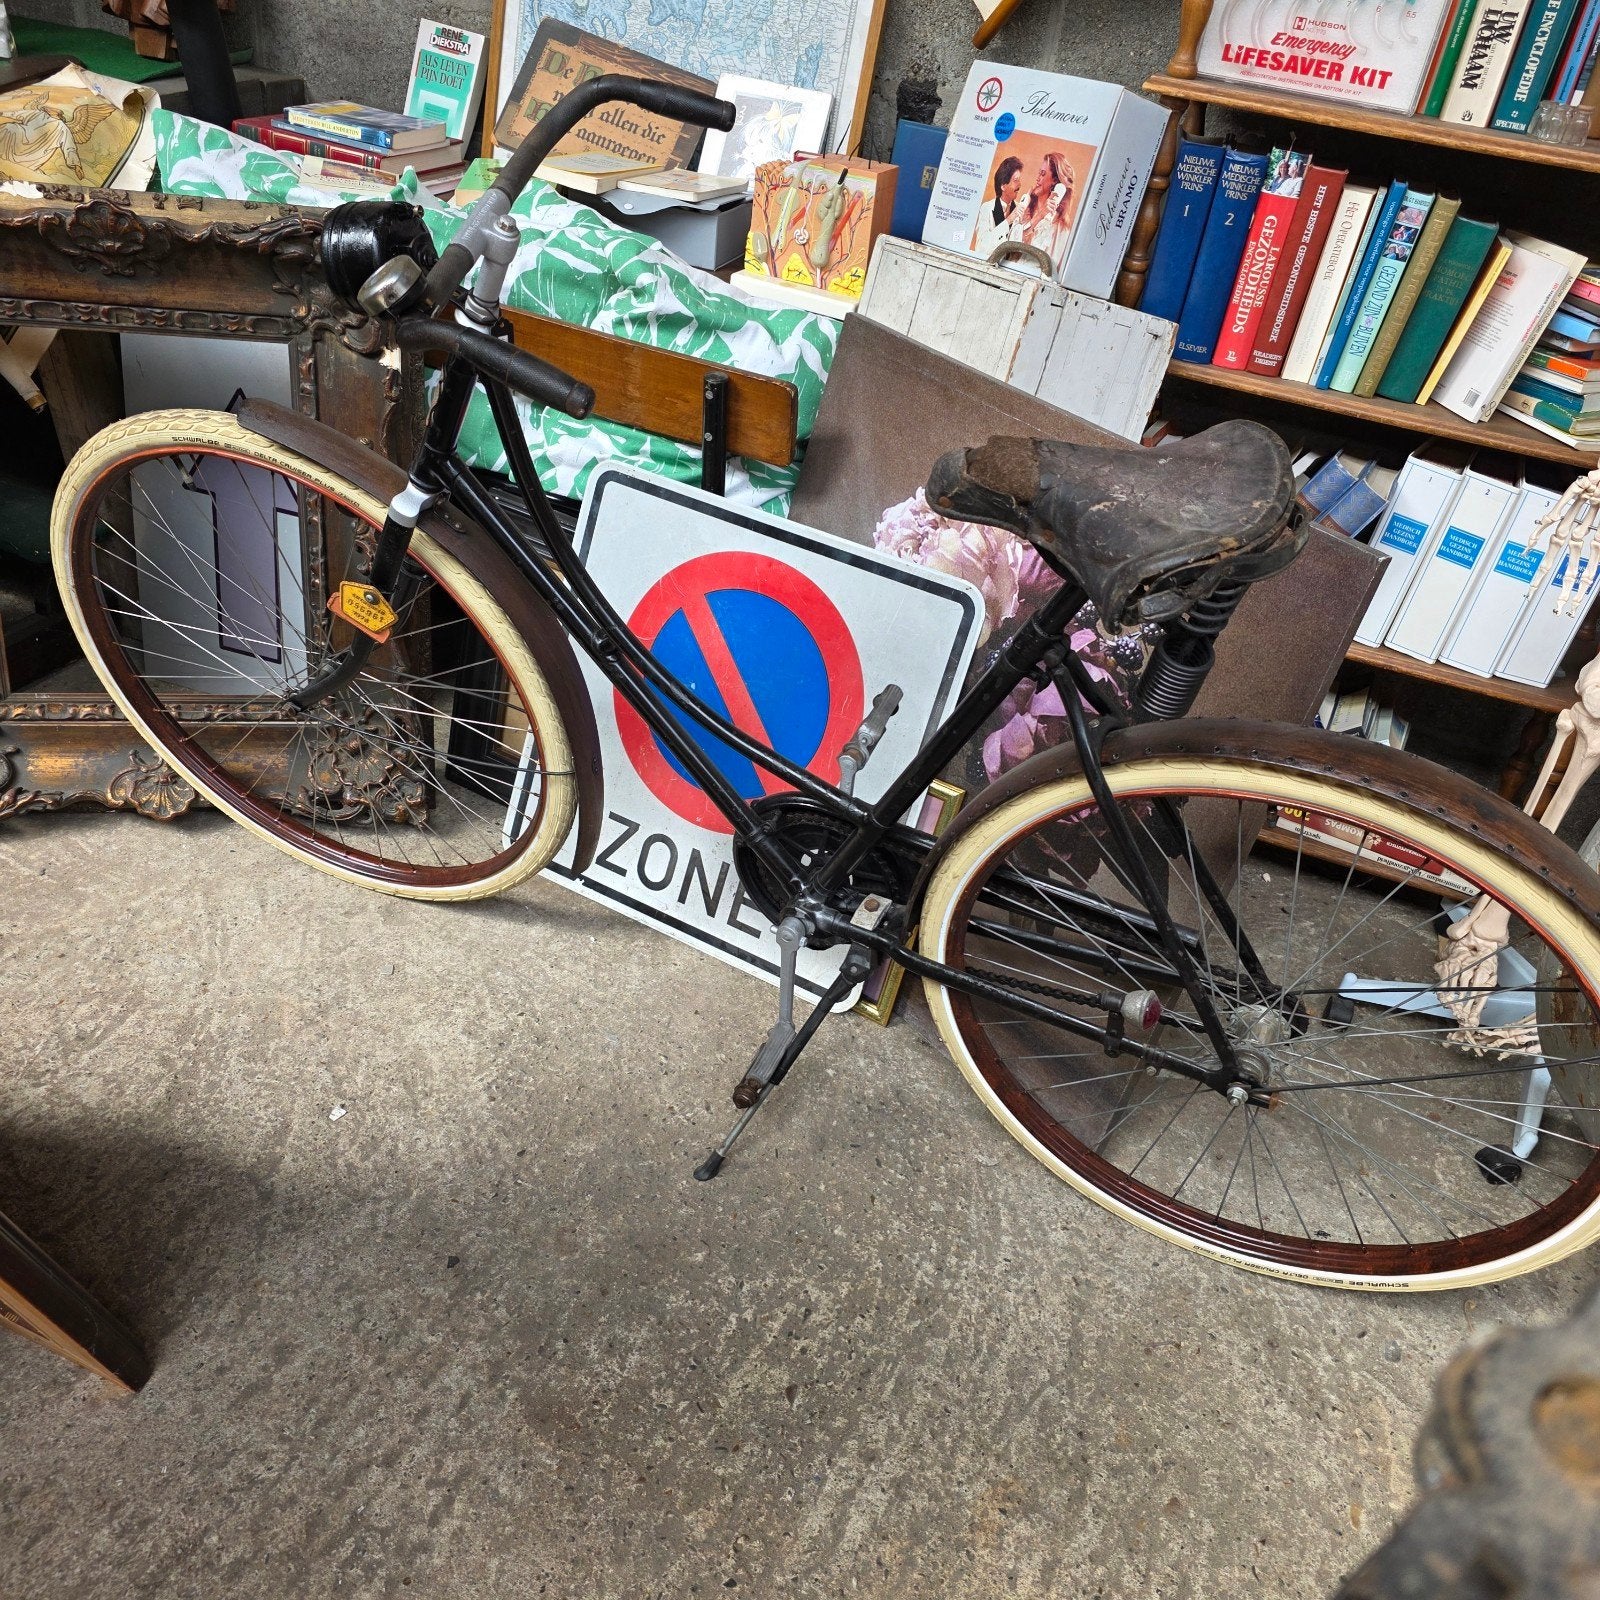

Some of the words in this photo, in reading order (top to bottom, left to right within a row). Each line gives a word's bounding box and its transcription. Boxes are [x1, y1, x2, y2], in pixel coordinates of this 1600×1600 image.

[1308, 19, 1347, 31] HUDSON
[1495, 11, 1519, 45] UW
[441, 27, 464, 41] RENÉ
[430, 33, 471, 55] DIEKSTRA
[1270, 32, 1357, 60] Emergency
[1460, 8, 1501, 91] LICHAAM
[1486, 54, 1494, 66] top
[1514, 11, 1558, 103] ENCYCLOPEDIE
[422, 54, 438, 68] ALS
[440, 58, 469, 77] LEVEN
[420, 67, 437, 83] PIJN
[440, 72, 465, 89] DOET
[1278, 76, 1314, 87] INSTRUCTIONS
[1322, 84, 1344, 94] BOTTOM
[1349, 65, 1393, 90] KIT
[599, 106, 641, 135] allen
[1495, 119, 1526, 132] SPECTRUM
[575, 126, 657, 165] aanroepen
[1183, 154, 1215, 168] NIEUWE
[1177, 162, 1217, 177] MEDISCHE
[1221, 170, 1261, 185] MEDISCHE
[1228, 163, 1260, 176] NIEUWE
[1177, 171, 1212, 185] WINKLER
[1180, 181, 1203, 193] PRINS
[1221, 180, 1257, 194] WINKLER
[1224, 189, 1249, 201] PRINS
[1115, 174, 1138, 229] BRAMO
[1313, 185, 1328, 209] HET
[1183, 204, 1190, 217] 1
[1224, 212, 1235, 226] 2
[1302, 209, 1320, 244] BESTE
[1232, 240, 1257, 305] ENCYCLOPEDIE
[1232, 215, 1278, 334] GEZONDHEIDS
[1253, 247, 1281, 308] LAROUSSE
[1363, 263, 1373, 279] voor
[1372, 265, 1398, 301] GEZOND
[1269, 245, 1308, 343] GEZONDHEIDSBOEK
[1364, 300, 1383, 320] ZIJN
[1178, 341, 1208, 354] ELSEVIER
[1349, 324, 1374, 358] BLIJVEN
[1253, 349, 1283, 361] READER'S
[1254, 357, 1278, 367] DIGEST
[171, 436, 220, 446] SCHWALBE
[254, 452, 278, 464] DELTA
[279, 461, 312, 480] CRUISER
[314, 477, 336, 492] PLUS
[1485, 488, 1491, 496] 2
[1393, 521, 1422, 536] MEDISCH
[1393, 528, 1415, 541] GEZINS
[1384, 531, 1417, 549] HANDBOEK
[1449, 534, 1478, 549] MEDISCH
[1449, 541, 1472, 554] GEZINS
[1440, 545, 1474, 562] HANDBOEK
[1498, 559, 1533, 577] HANDBOEK
[1507, 556, 1531, 569] GEZINS
[1324, 818, 1364, 838] KOMPAS
[595, 811, 761, 939] ZONE
[1220, 1254, 1243, 1265] PLUS
[1244, 1262, 1280, 1275] CRUISER
[1282, 1271, 1309, 1280] DELTA
[1348, 1281, 1409, 1289] SCHWALBE
